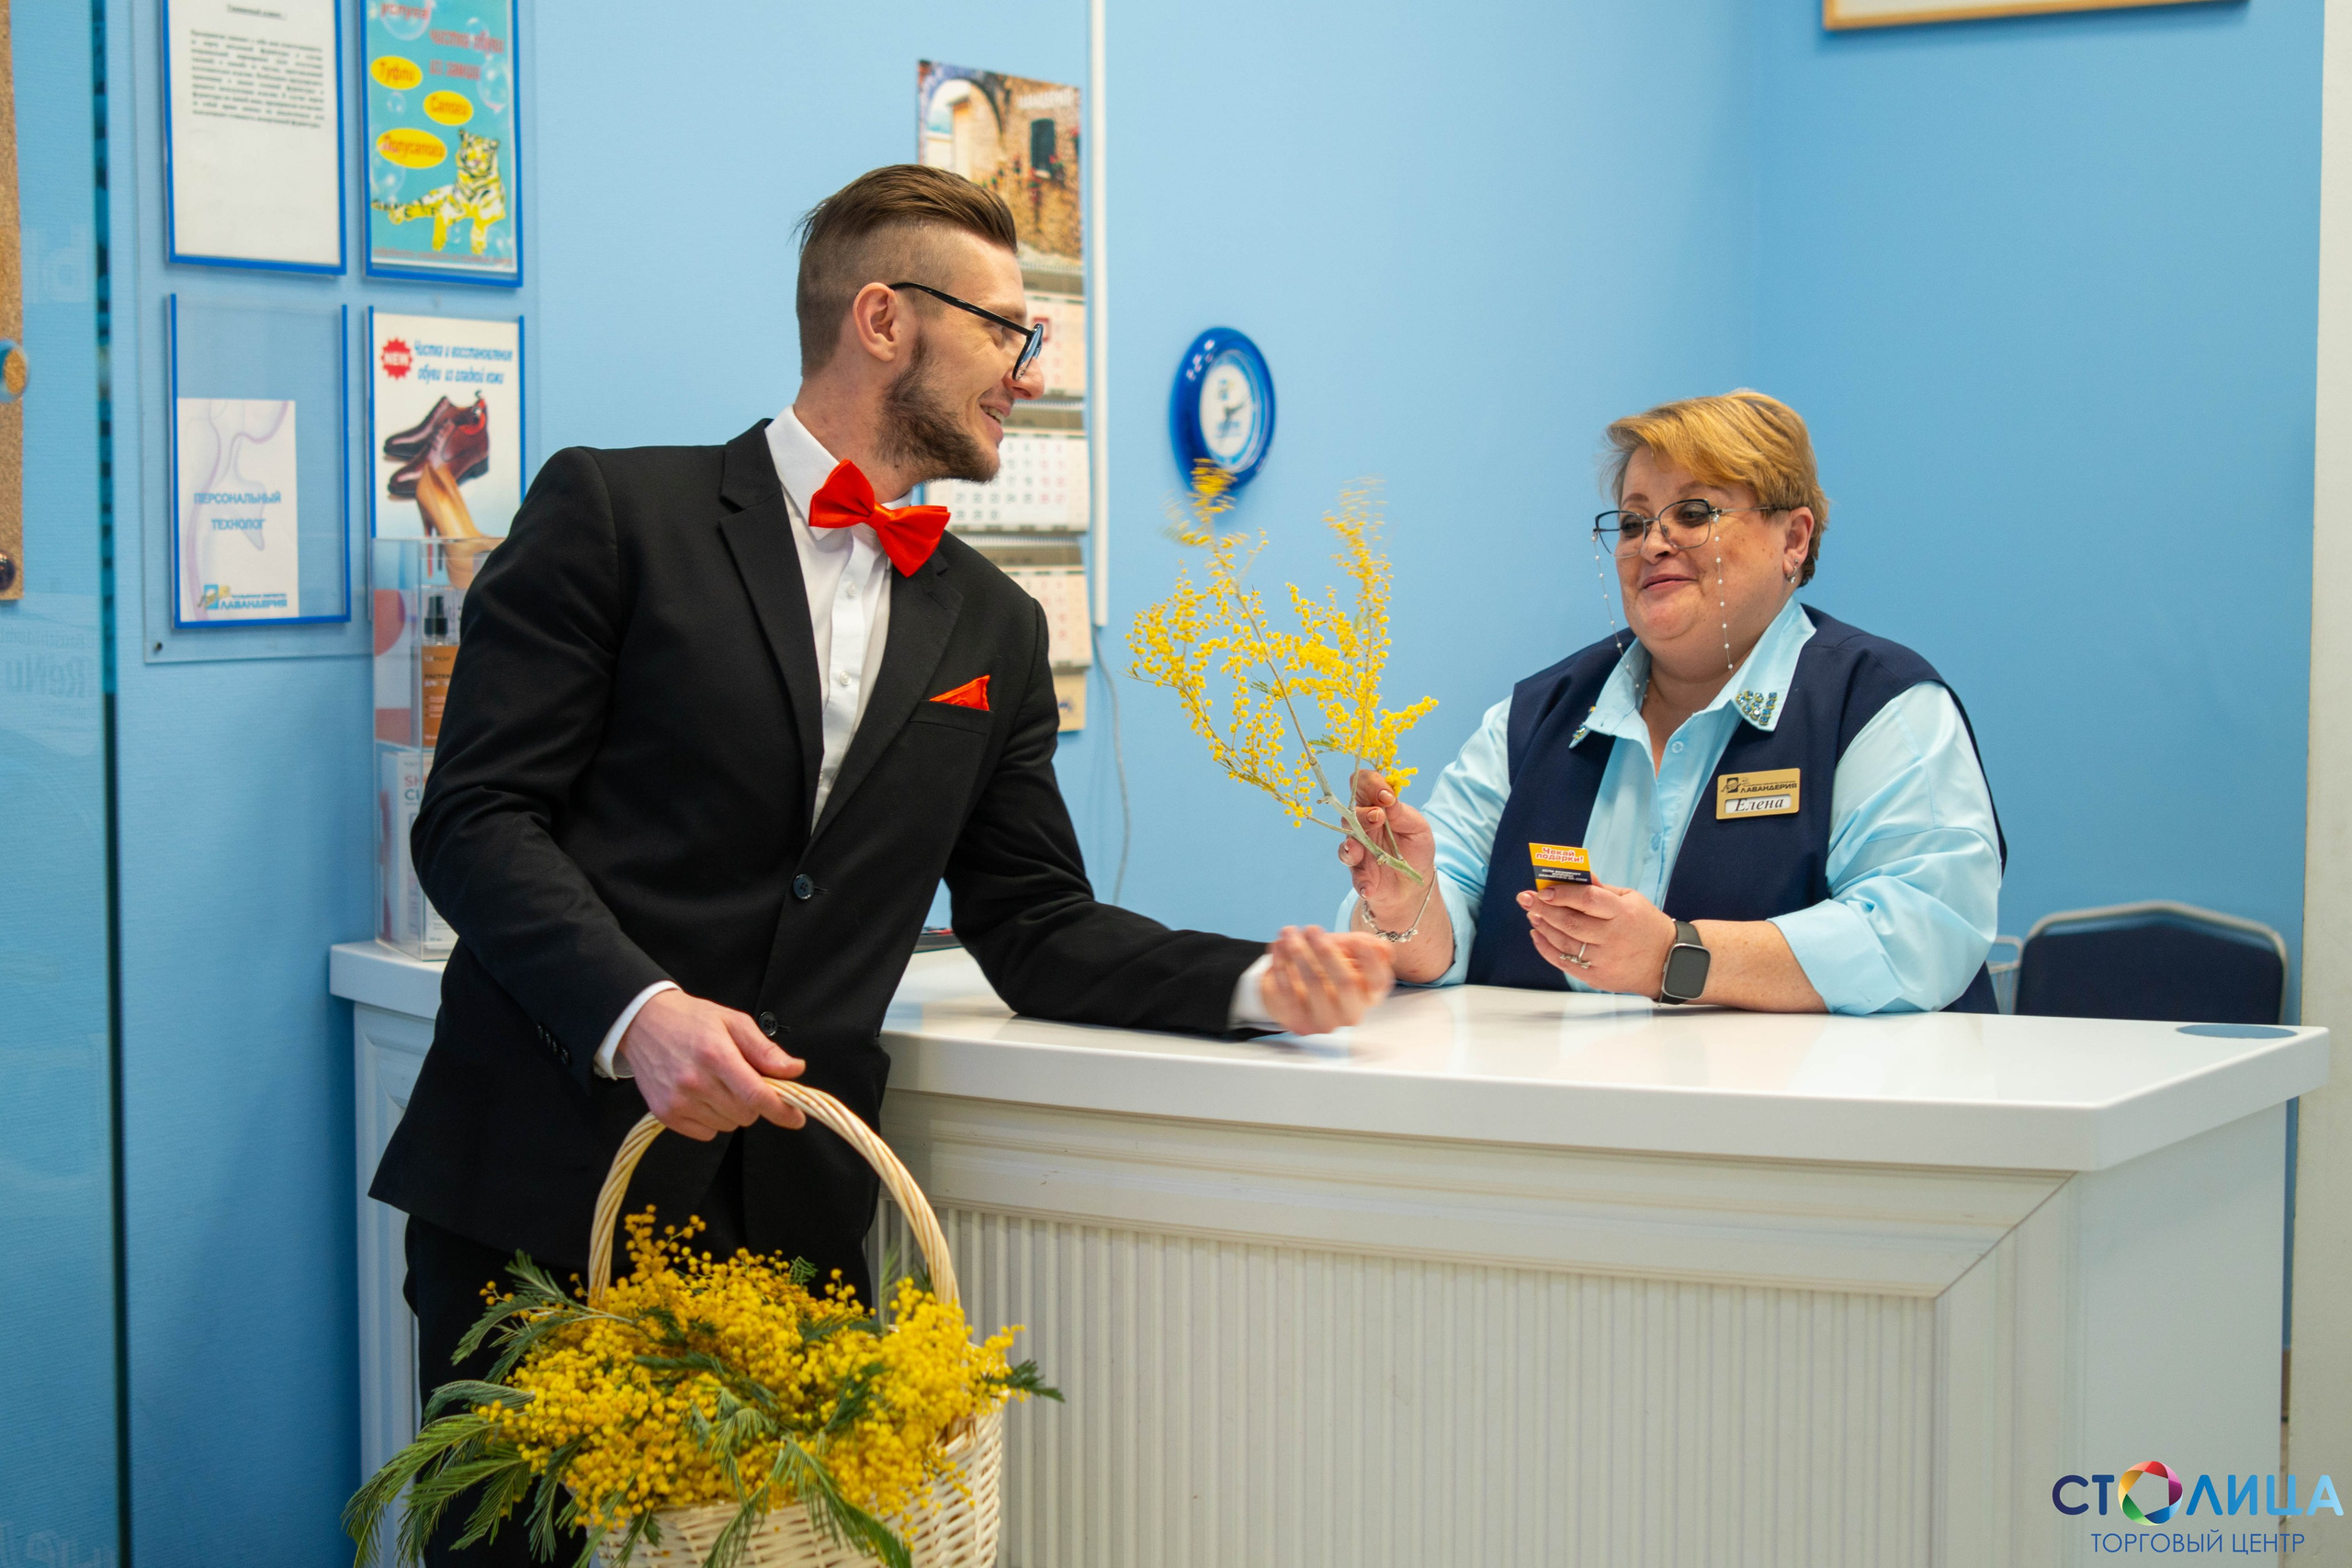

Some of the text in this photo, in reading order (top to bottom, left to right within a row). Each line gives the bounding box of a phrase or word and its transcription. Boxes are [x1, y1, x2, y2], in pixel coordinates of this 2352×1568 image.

[383, 352, 411, 366] NEW
[194, 491, 281, 504] ПЕРСОНАЛЬНЫЙ
[211, 518, 266, 530] ТЕХНОЛОГ
[1740, 783, 1797, 794] ЛАВАНДЕРИЯ
[1735, 797, 1784, 812] Елена
[1536, 853, 1583, 863] подарки!
[1543, 847, 1575, 857] Чекай
